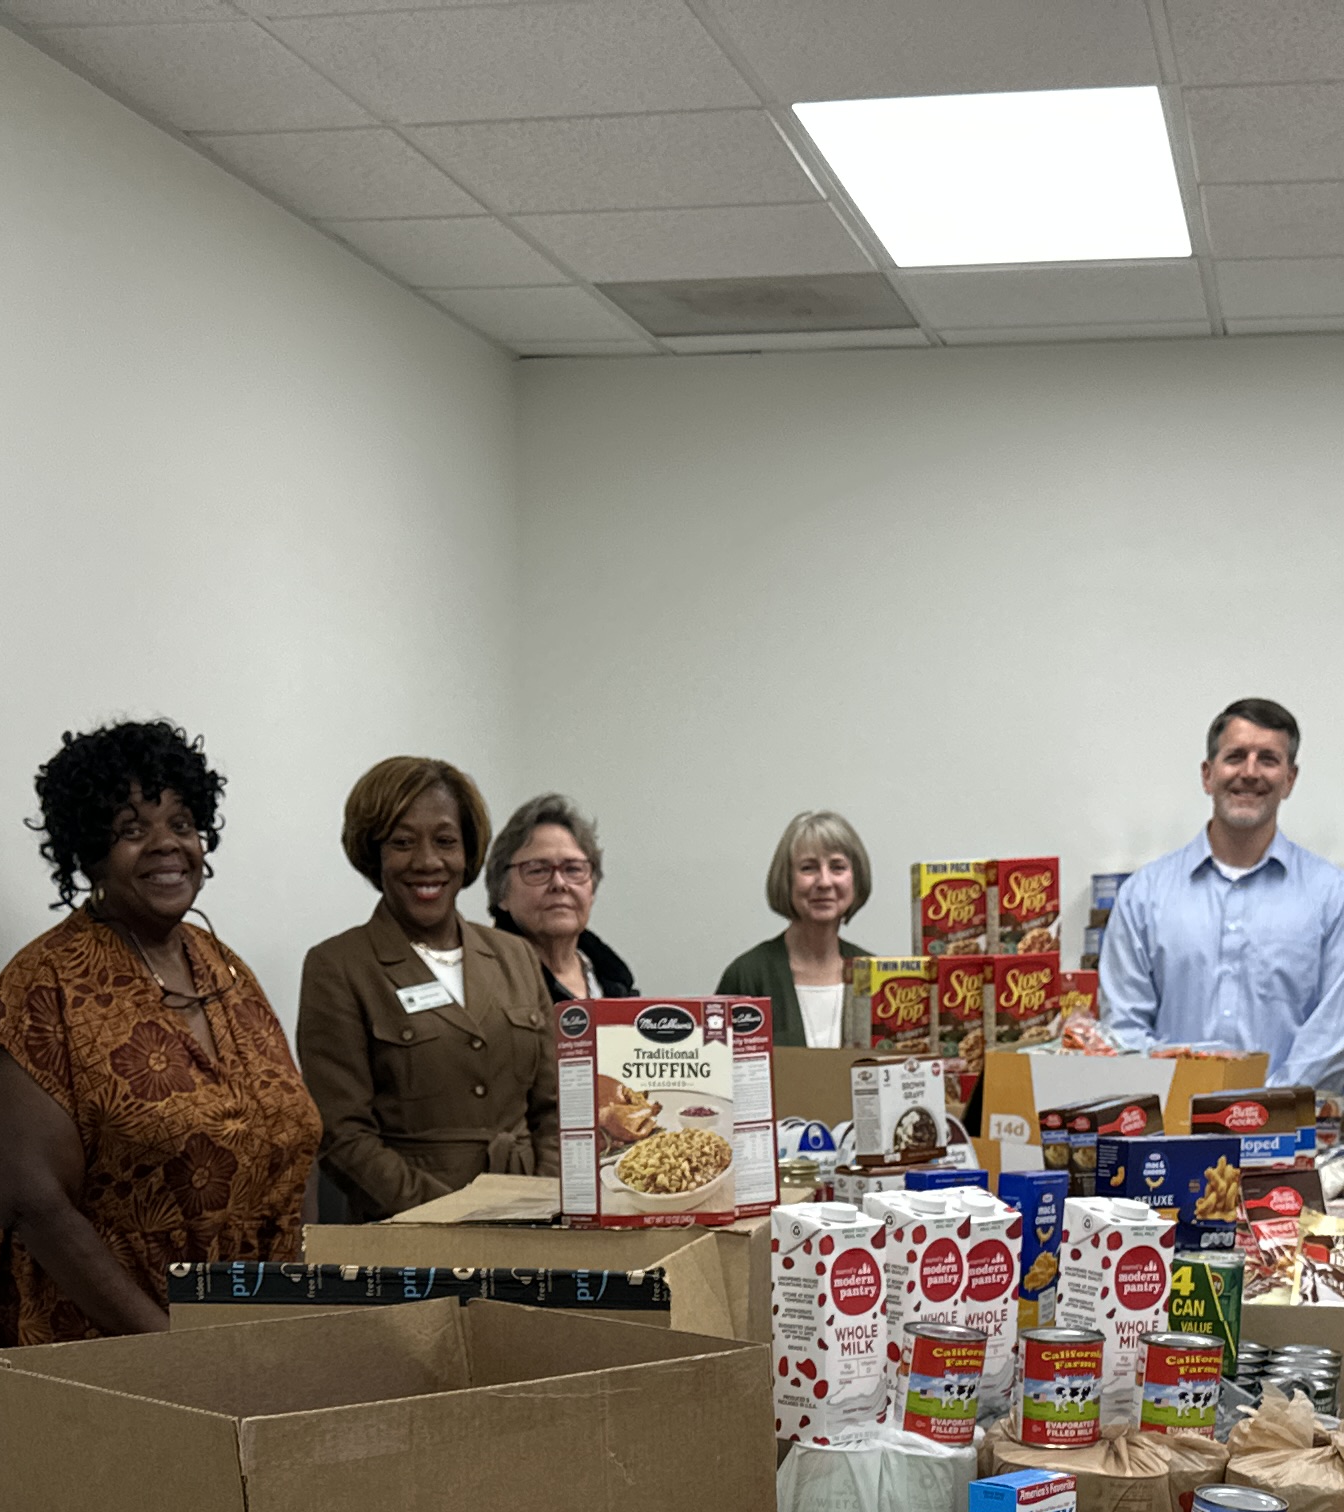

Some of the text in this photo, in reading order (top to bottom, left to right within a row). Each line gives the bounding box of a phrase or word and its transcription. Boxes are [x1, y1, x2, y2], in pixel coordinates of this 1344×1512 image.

[926, 863, 970, 873] TWIN PACK
[1003, 871, 1053, 909] Stove
[928, 883, 983, 920] Stove
[1019, 891, 1048, 916] Top
[947, 905, 976, 927] Top
[877, 961, 921, 971] TWIN PACK
[1000, 968, 1053, 1008] Stove
[1018, 990, 1046, 1014] Top
[895, 1003, 924, 1025] Top
[634, 1048, 699, 1060] Traditional
[622, 1062, 711, 1078] STUFFING
[994, 1120, 1025, 1137] 14d
[923, 1264, 958, 1276] modern
[1119, 1272, 1160, 1282] modern
[833, 1274, 875, 1288] modern
[927, 1274, 959, 1289] pantry
[971, 1274, 1008, 1289] pantry
[1123, 1281, 1161, 1294] pantry
[1172, 1266, 1194, 1296] 4
[839, 1285, 877, 1301] pantry
[1172, 1299, 1205, 1316] CAN
[965, 1309, 1008, 1326] WHOLE
[835, 1324, 878, 1342] WHOLE
[1115, 1320, 1159, 1334] WHOLE
[1181, 1321, 1213, 1333] VALUE
[840, 1341, 874, 1356] MILK
[1045, 1420, 1095, 1430] EVAPORATED
[1046, 1427, 1093, 1436] FILLED MILK
[1019, 1480, 1076, 1502] America's Favorite
